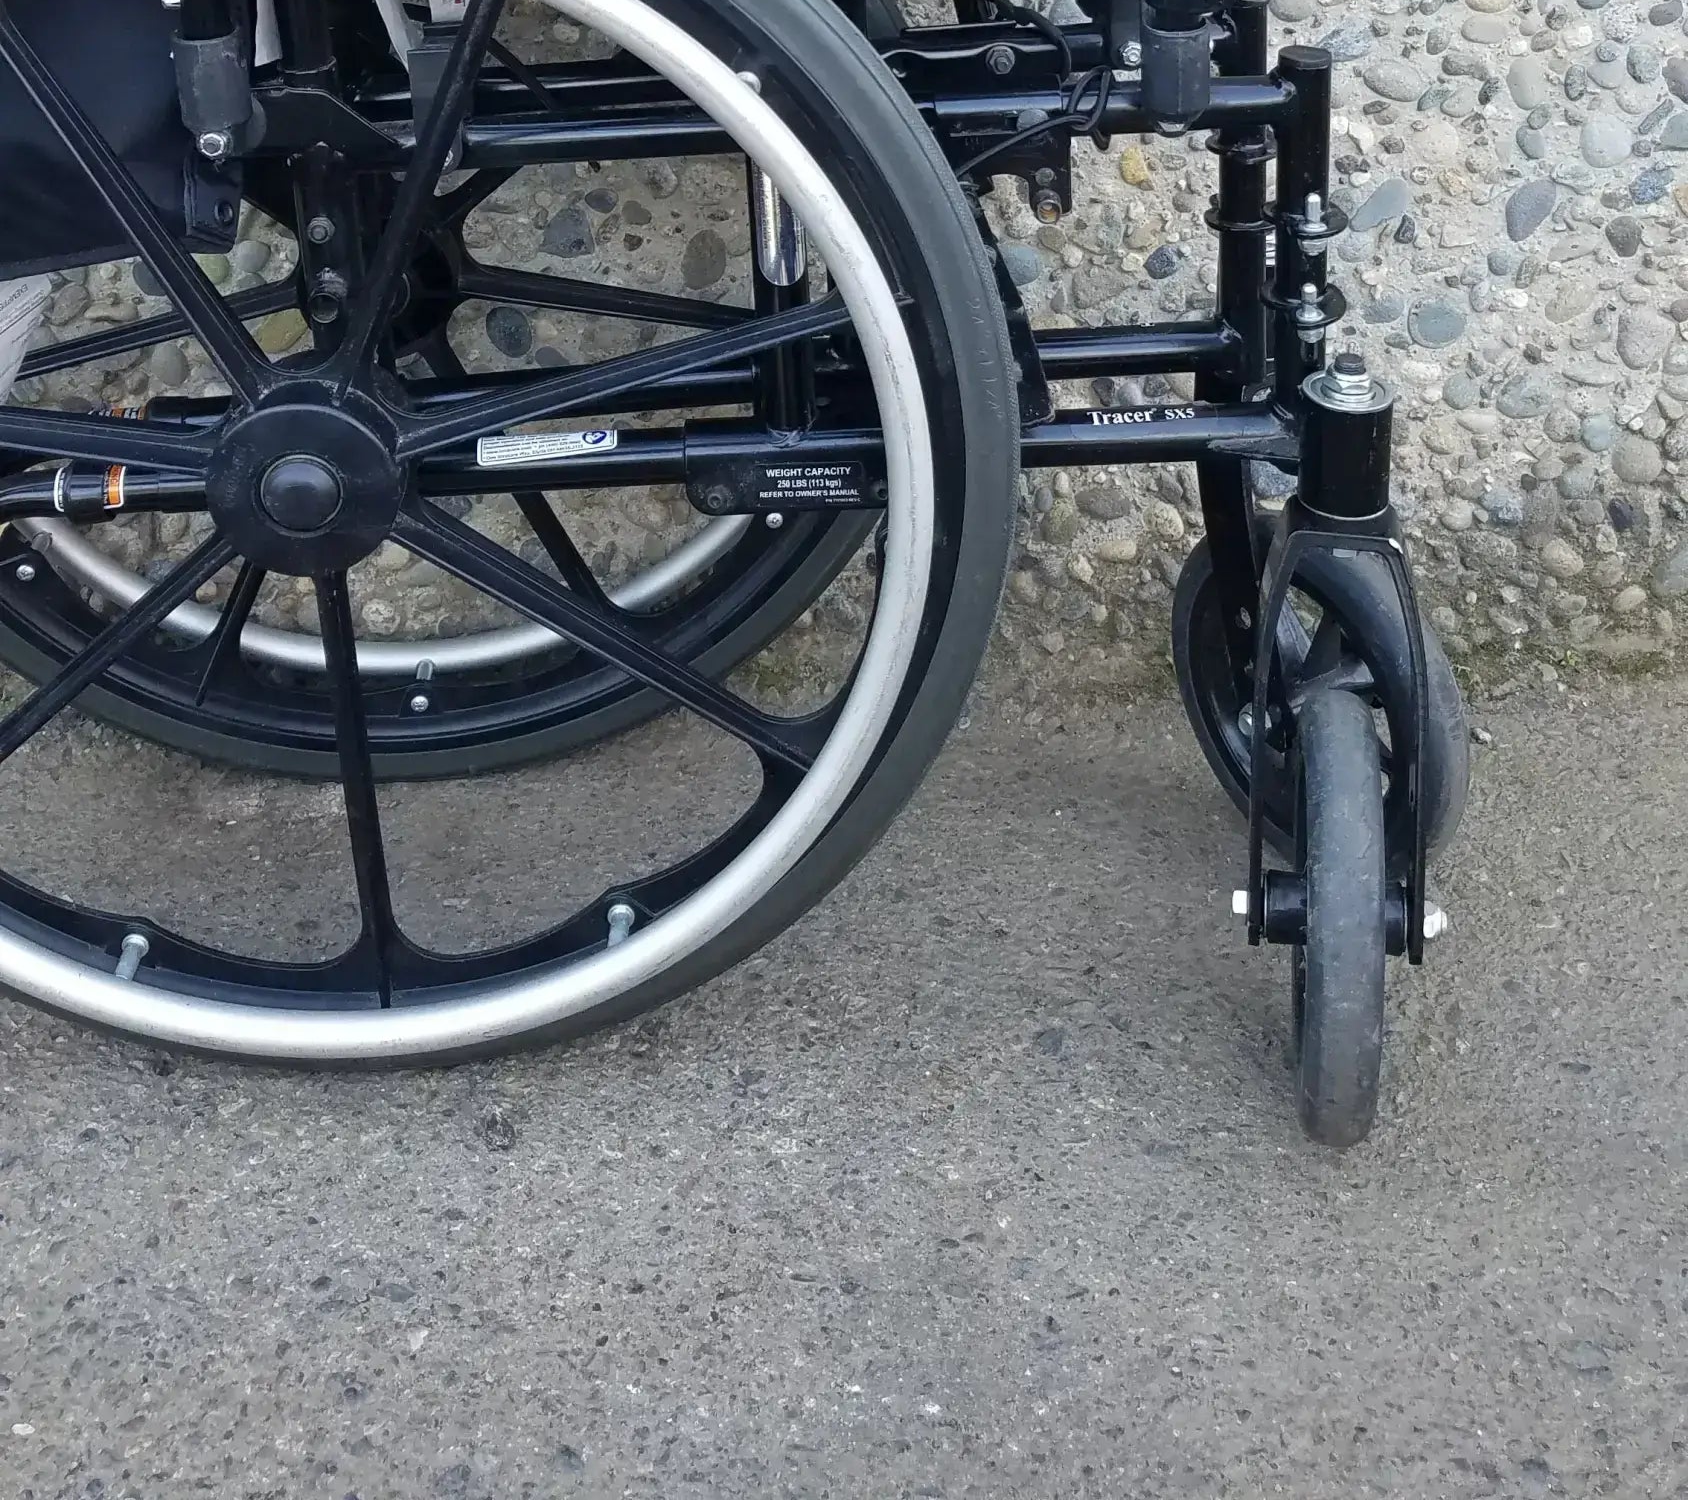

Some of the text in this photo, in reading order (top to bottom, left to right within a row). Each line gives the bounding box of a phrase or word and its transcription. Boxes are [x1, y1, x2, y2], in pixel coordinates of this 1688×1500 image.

[1087, 407, 1195, 426] Tracer SX5
[766, 466, 851, 478] WEIGHT CAPACITY
[777, 478, 842, 489] 250 LBS (113 kgs)
[795, 489, 828, 497] OWNER'S
[829, 488, 860, 496] MANUAL
